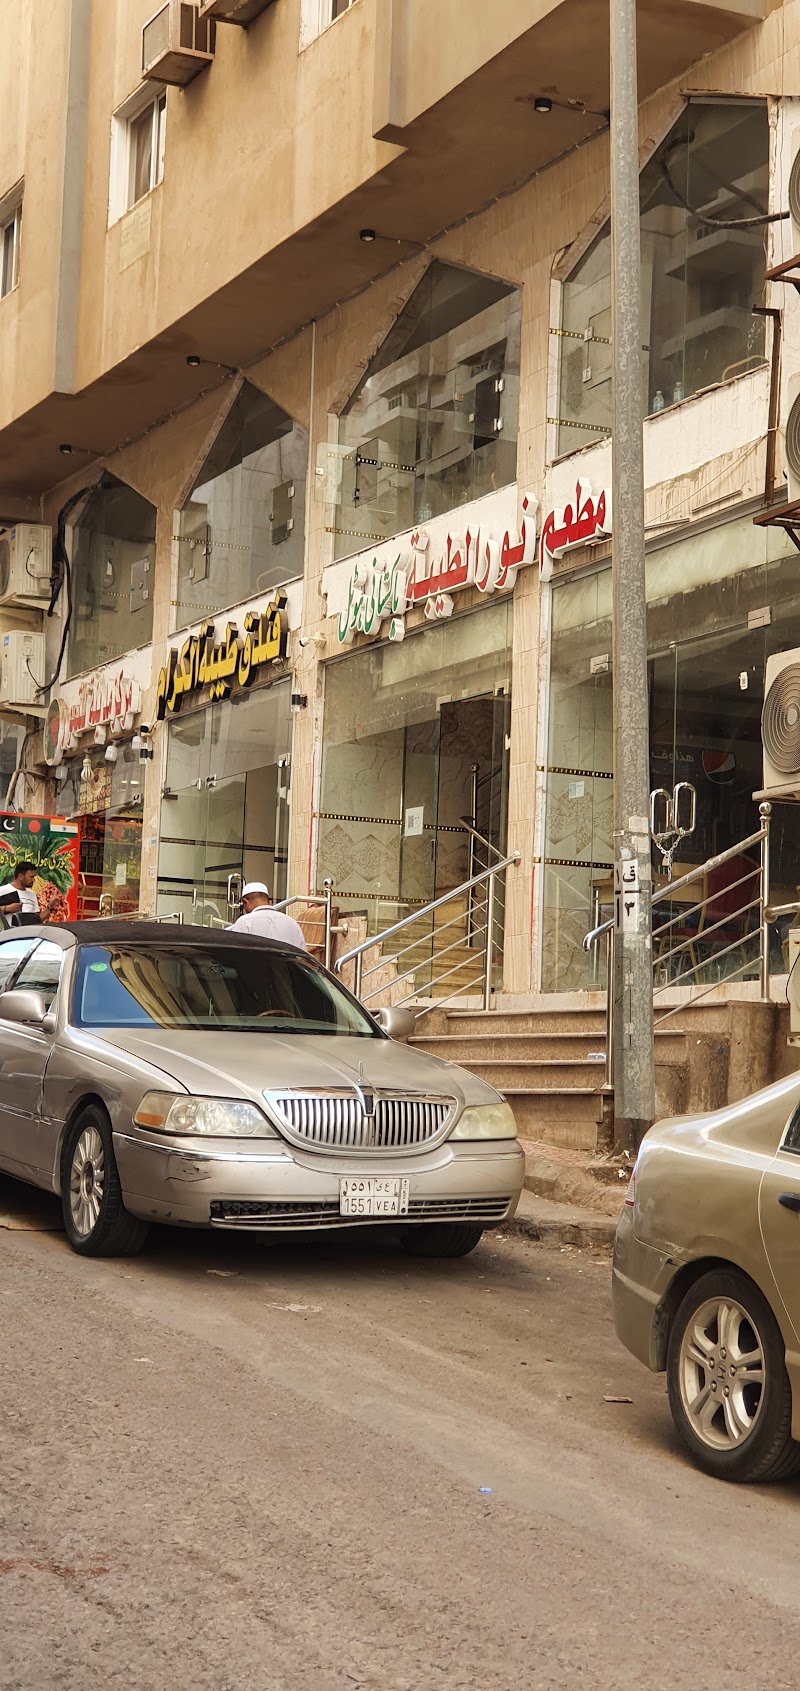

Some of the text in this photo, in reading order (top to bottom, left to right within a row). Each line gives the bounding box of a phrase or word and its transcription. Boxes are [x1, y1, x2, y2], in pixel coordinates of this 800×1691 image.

[406, 478, 611, 618] مطعم نور الطيبة
[156, 588, 288, 720] فندق طيبة الكرام
[622, 865, 636, 882] ق
[624, 901, 635, 917] ٣
[345, 1198, 396, 1213] 1551 VEA
